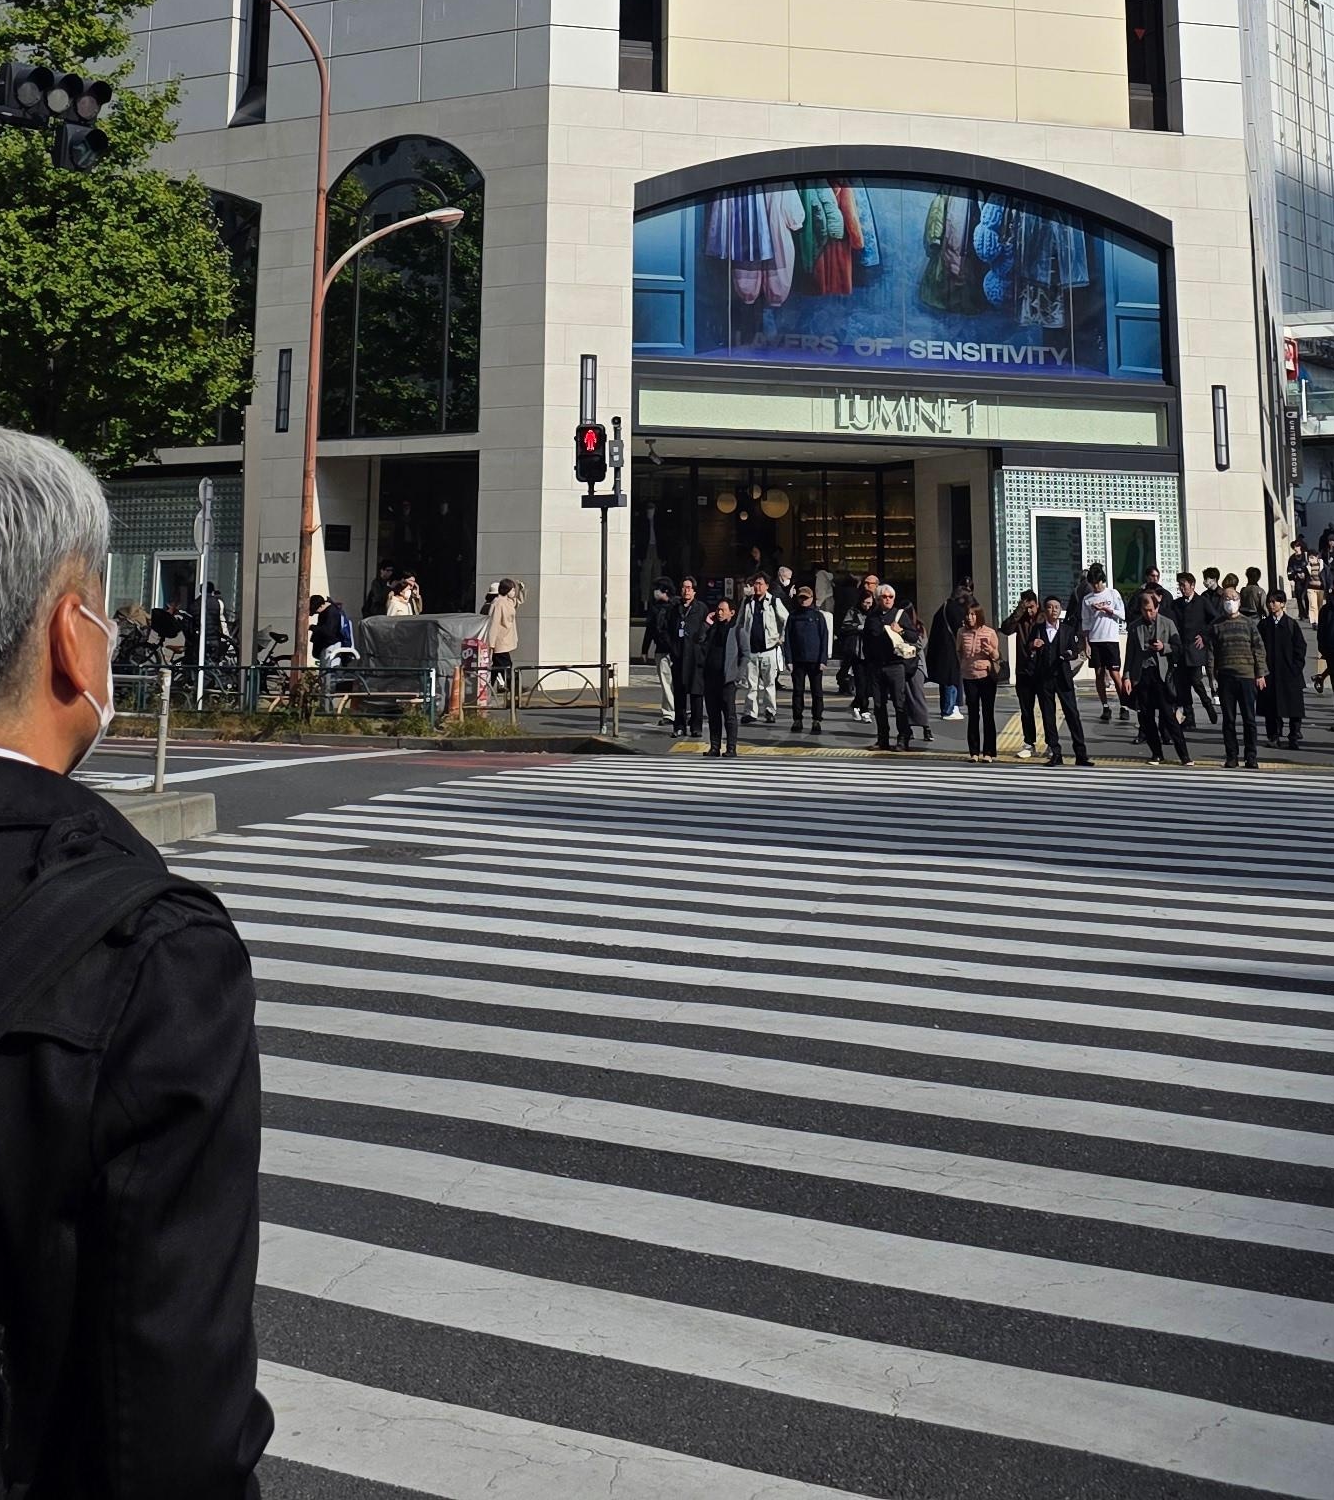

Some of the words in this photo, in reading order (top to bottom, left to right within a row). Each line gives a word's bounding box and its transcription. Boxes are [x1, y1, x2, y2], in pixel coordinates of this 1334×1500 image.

[734, 330, 839, 356] LAYERS
[854, 337, 893, 357] OF
[908, 340, 1069, 366] SENSITIVITY
[835, 393, 958, 434] LUMINE
[961, 399, 978, 435] 1
[259, 551, 290, 564] UMINE
